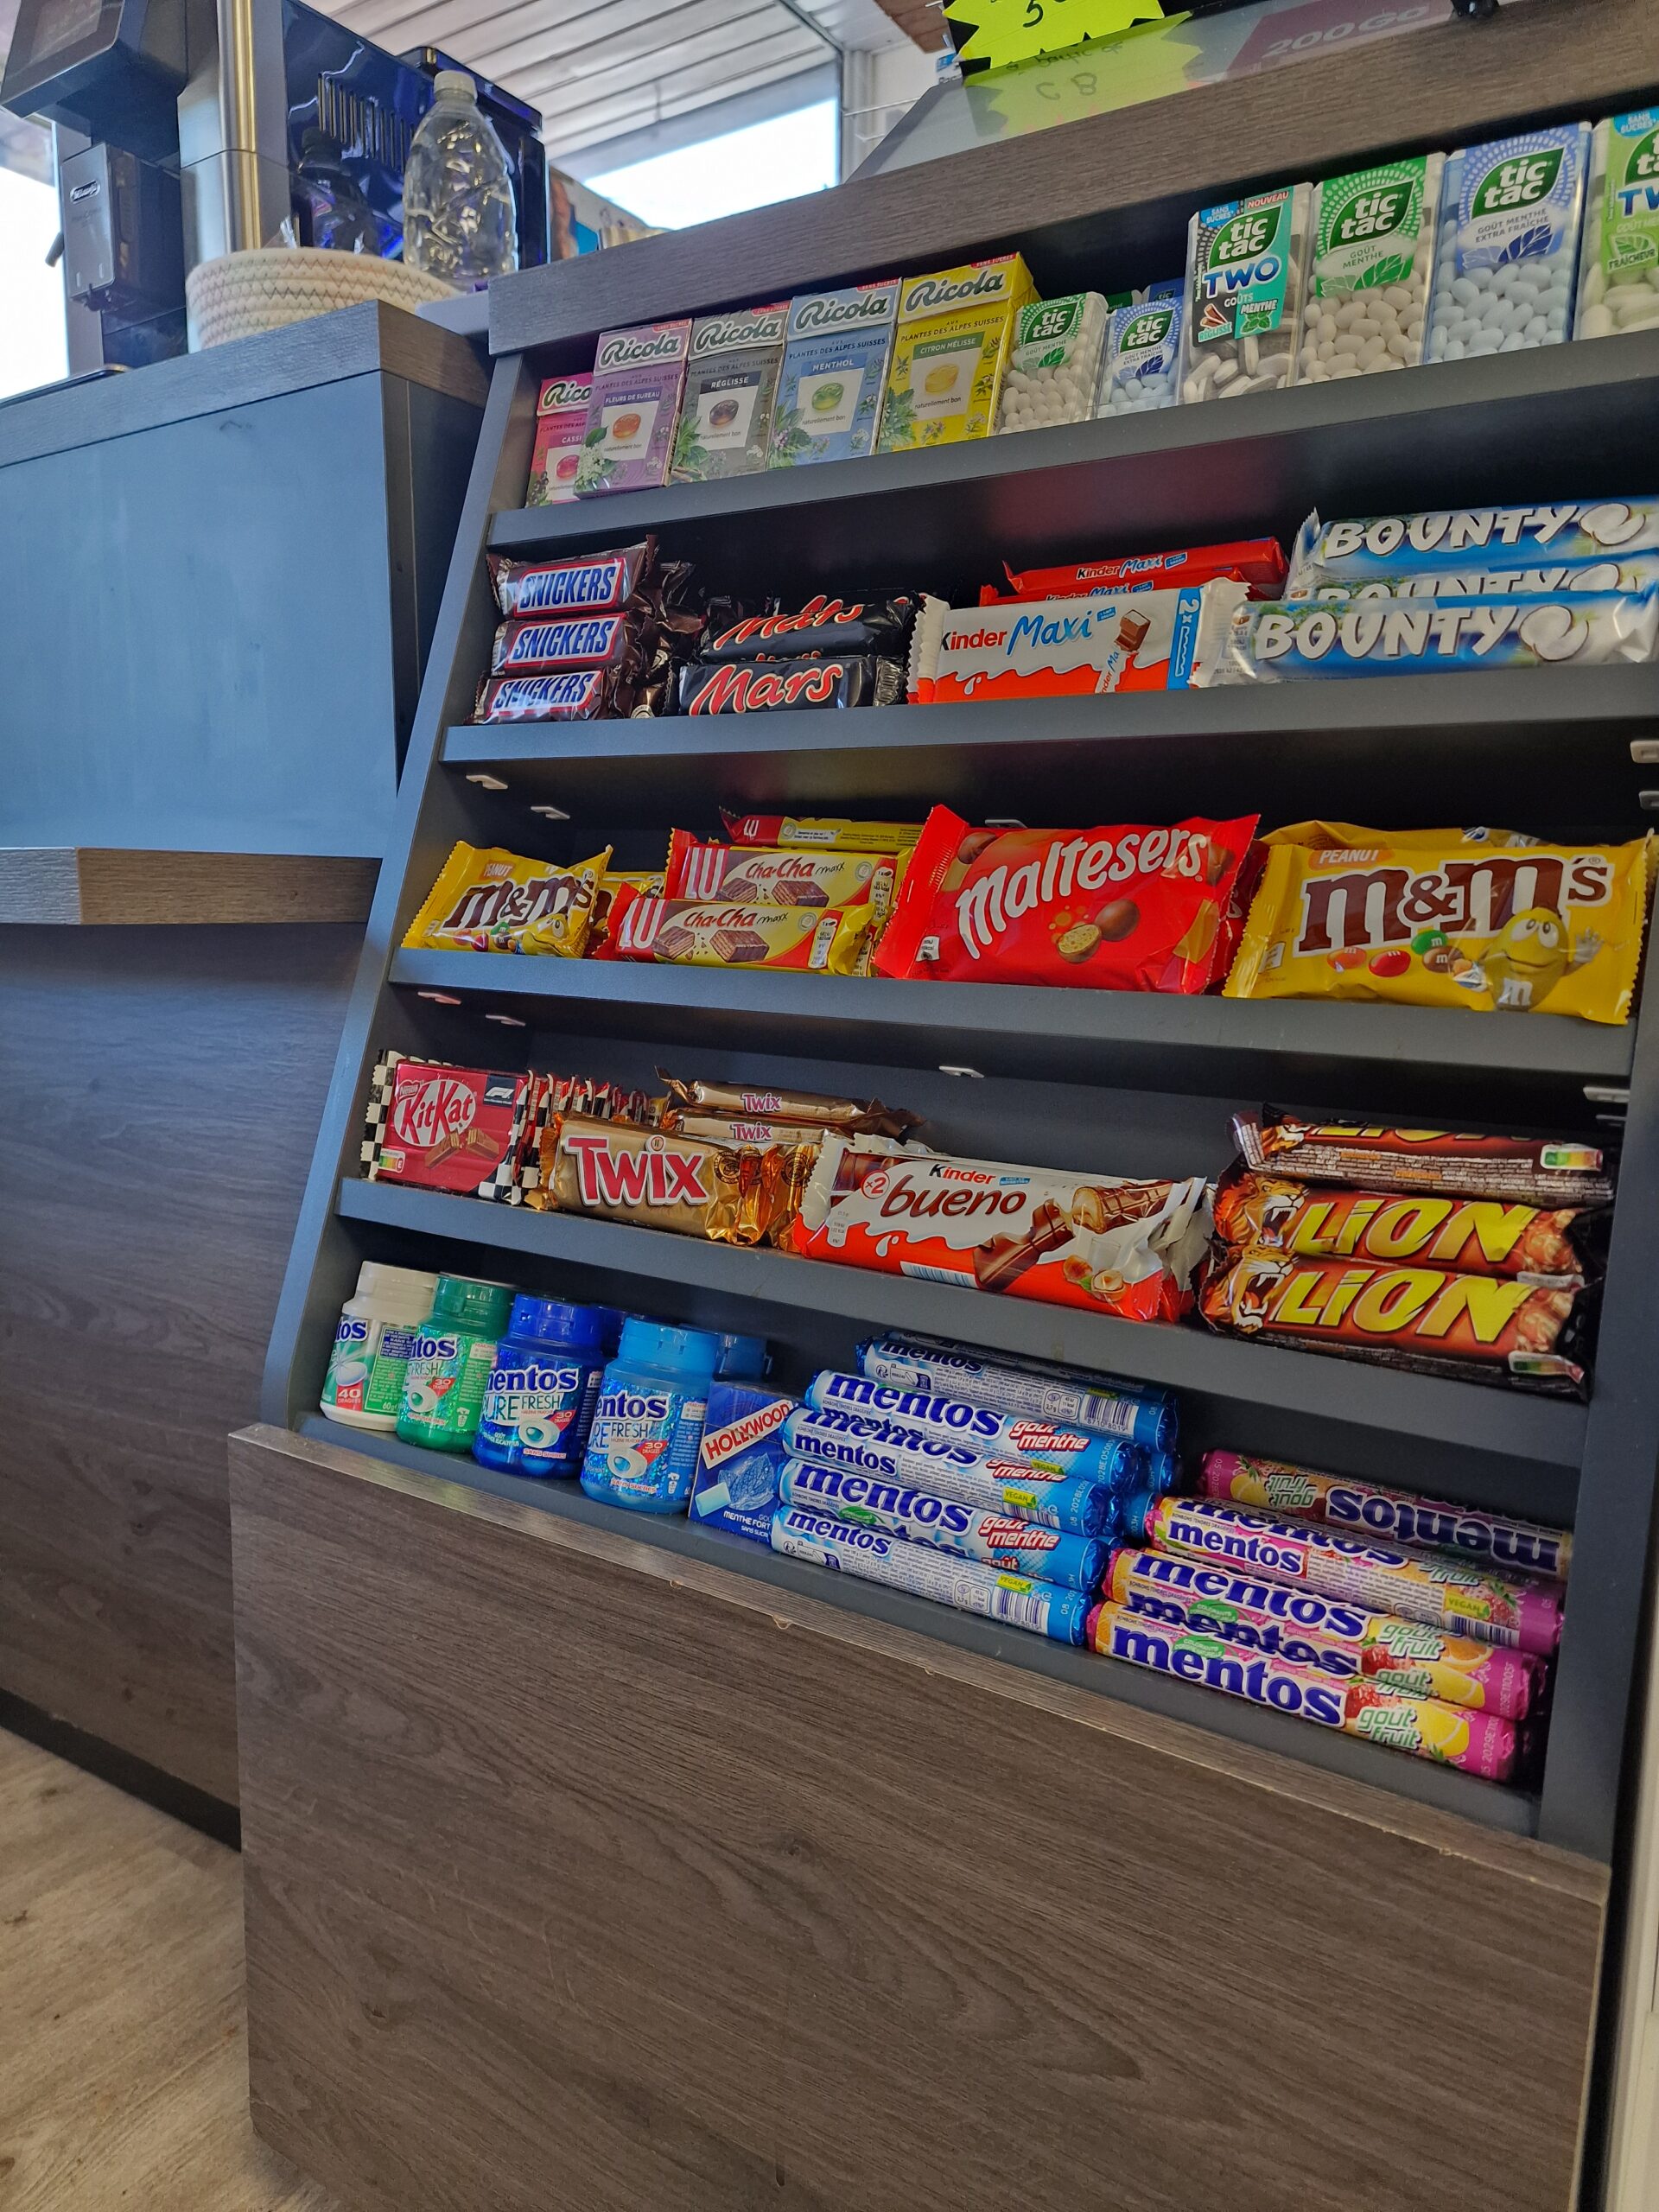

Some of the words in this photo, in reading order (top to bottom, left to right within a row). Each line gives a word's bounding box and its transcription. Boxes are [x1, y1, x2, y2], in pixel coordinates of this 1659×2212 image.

[1499, 157, 1549, 188] tic
[1247, 191, 1290, 209] NOUVEAU
[1355, 192, 1400, 220] tic
[1484, 179, 1544, 209] tac
[1211, 206, 1230, 216] SANS
[1478, 219, 1503, 234] GOÛT
[1506, 208, 1548, 226] MENTHE
[1230, 218, 1268, 243] tic
[1340, 213, 1395, 240] tac
[1476, 228, 1506, 244] EXTRA
[1218, 234, 1266, 261] tac
[1343, 251, 1384, 270] MENTHE
[906, 270, 1004, 312] Ricola
[1202, 257, 1281, 299] TWO
[794, 293, 888, 330] Ricola
[1042, 308, 1069, 324] tic
[1240, 299, 1279, 315] MENTHE
[695, 316, 780, 353] Ricola
[901, 330, 931, 342] PLANTES
[933, 327, 948, 335] DES
[949, 323, 971, 334] ALPES
[973, 316, 1004, 327] SUISSES
[1033, 321, 1065, 339] tac
[1136, 315, 1165, 334] tic
[600, 333, 680, 367] Ricola
[789, 348, 818, 359] PLANTES
[820, 346, 834, 354] DES
[835, 343, 855, 353] ALPES
[857, 337, 886, 348] SUISSES
[920, 343, 945, 354] CITRON
[947, 337, 976, 350] MÉLISSE
[1042, 340, 1067, 352] MENTHE
[1127, 329, 1162, 347] tac
[812, 359, 855, 372] MENTHOL
[542, 380, 594, 407] Rico
[710, 376, 749, 389] RÉGLISSE
[605, 394, 626, 404] FLEURS
[637, 391, 660, 400] SUREAU
[914, 397, 950, 410] naturellement
[950, 396, 962, 404] bon
[562, 435, 582, 444] CASSI
[1325, 505, 1580, 558] BOUNTY
[1077, 566, 1120, 580] Kinder
[1119, 556, 1163, 578] Maxi
[519, 565, 617, 609] SNICKERS
[512, 620, 615, 661] SNICKERS
[939, 629, 1008, 653] Kinder
[1007, 608, 1094, 656] Maxi
[1255, 605, 1519, 660] BOUNTY
[493, 672, 594, 709] SNICKERS
[689, 663, 844, 717] Mars
[684, 847, 726, 899] LU
[619, 899, 665, 950] LU
[399, 1080, 474, 1145] KitKat
[741, 1093, 782, 1113] Twix
[731, 1122, 772, 1141] Twix
[565, 1135, 709, 1206] Twix
[929, 1163, 996, 1185] Kinder
[880, 1173, 1027, 1218] bueno
[880, 1341, 984, 1373] mentos
[338, 1389, 361, 1399] 40
[522, 1395, 560, 1410] FRESH
[594, 1393, 668, 1419] entos
[825, 1374, 1007, 1439] mentos
[611, 1421, 648, 1439] FRESH
[705, 1402, 791, 1461] HOLLYWOOD
[1018, 1433, 1091, 1451] menthe
[794, 1433, 897, 1476] mentos
[611, 1478, 628, 1487] SANS
[793, 1463, 975, 1535] mentos
[1004, 1490, 1029, 1503] VEGAN
[723, 1510, 752, 1526] MENTHE
[753, 1519, 771, 1530] FORT
[1327, 1486, 1560, 1573] mentos
[785, 1511, 893, 1557] mentos
[987, 1529, 1062, 1550] menthe
[1168, 1520, 1302, 1574] mentos
[999, 1574, 1025, 1587] VEGAN
[1132, 1553, 1368, 1641] mentos
[1448, 1597, 1481, 1613] VEGAN
[1389, 1638, 1445, 1658] fruit
[1112, 1625, 1342, 1726] mentos
[1359, 1707, 1417, 1730] goût
[1370, 1727, 1421, 1749] fruit
